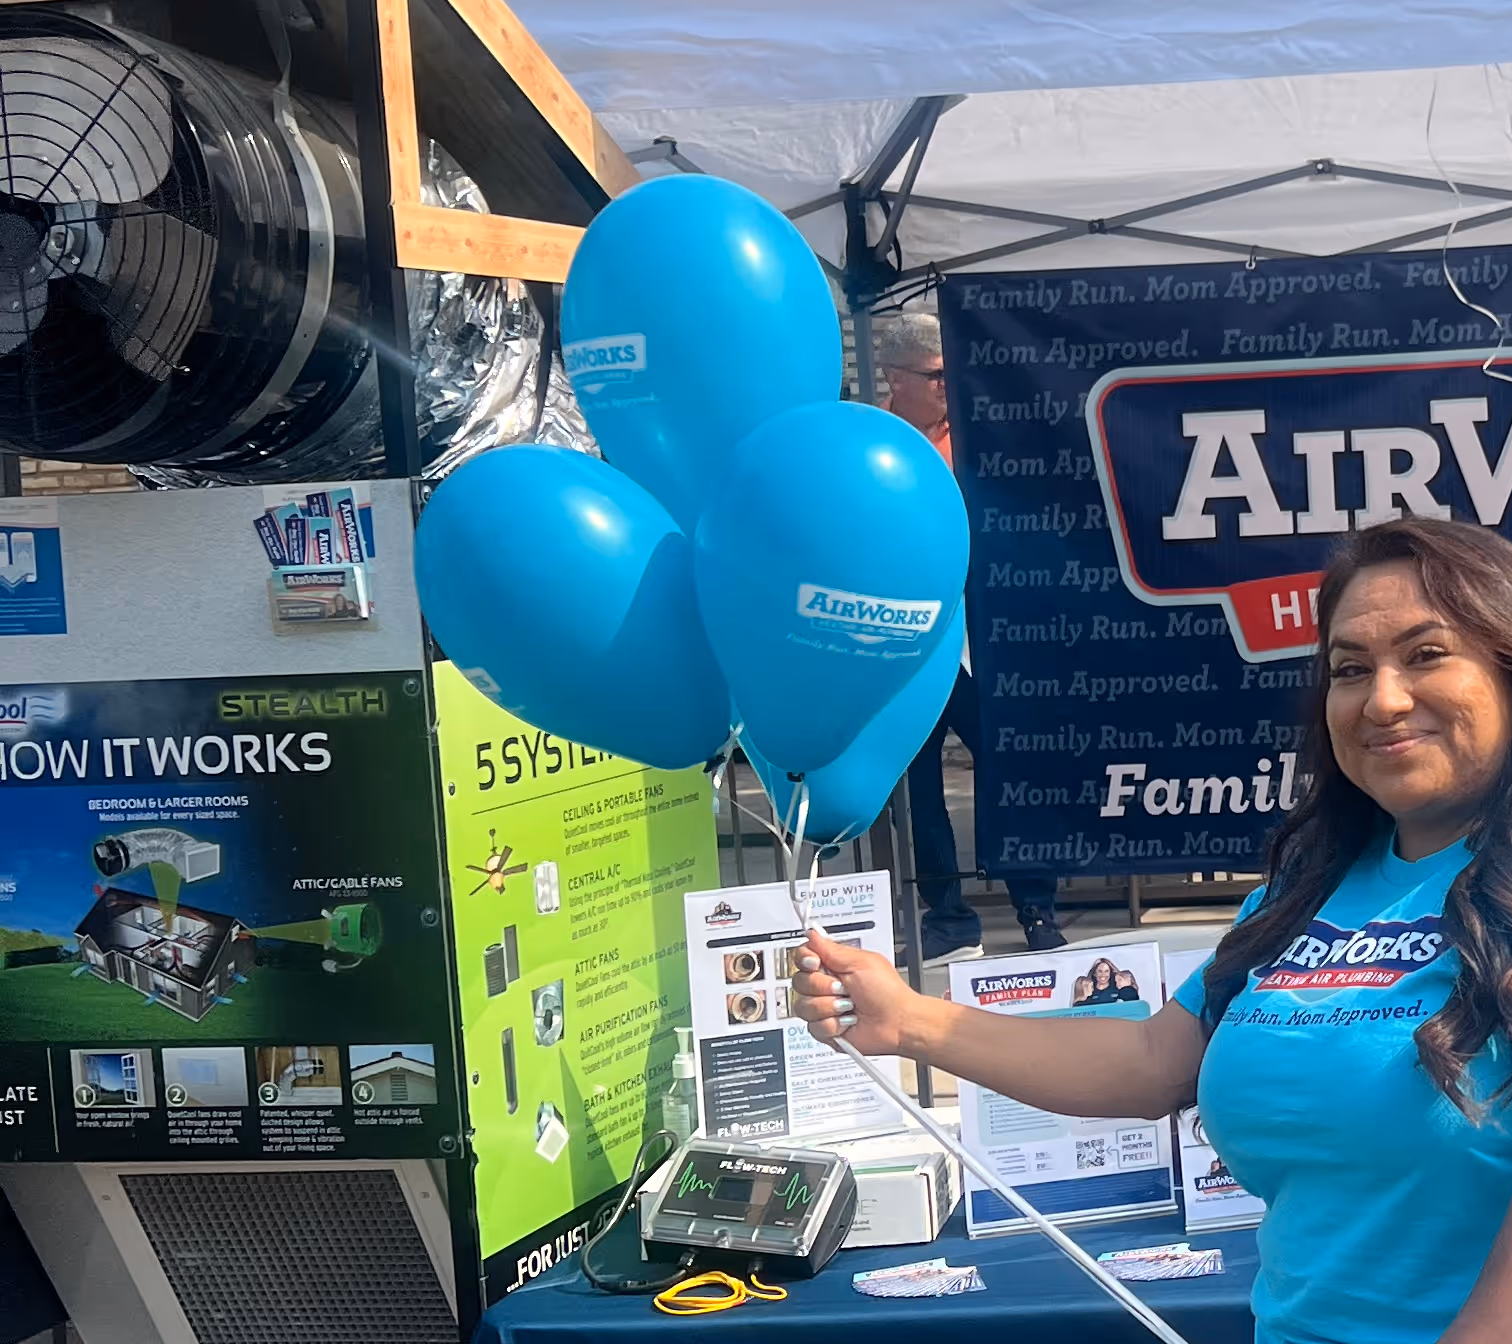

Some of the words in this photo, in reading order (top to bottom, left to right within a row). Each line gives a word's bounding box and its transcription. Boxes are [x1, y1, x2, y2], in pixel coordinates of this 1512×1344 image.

[961, 280, 1061, 313] Family
[1069, 279, 1136, 306] Run.
[1144, 275, 1219, 303] Mom
[1224, 262, 1382, 304] Approved.
[1402, 255, 1509, 290] Family
[970, 390, 1070, 426] Family
[806, 591, 932, 625] AIRWORKS
[222, 690, 385, 718] STEALTH
[102, 737, 140, 778] IT
[147, 732, 332, 777] WORKS
[476, 742, 495, 791] 5
[1100, 752, 1314, 818] Famil
[88, 798, 147, 810] BEDROOM
[149, 798, 156, 808] &
[158, 797, 204, 808] LARGER
[205, 795, 249, 806] ROOMS
[563, 803, 595, 823] CEILING
[597, 801, 602, 814] &
[604, 789, 643, 811] PORTABLE
[644, 783, 664, 801] FANS
[370, 876, 403, 889] FANS
[568, 869, 606, 891] CENTRAL
[607, 863, 621, 878] A/C
[821, 888, 838, 898] UP
[842, 884, 874, 895] WITH
[575, 955, 598, 976] ATTIC
[599, 948, 620, 964] FANS
[1271, 930, 1444, 970] IRWORKS
[976, 974, 1053, 994] AIRWORKS
[1310, 972, 1331, 985] AIR
[1335, 970, 1396, 985] PLUMBING
[985, 990, 1018, 1003] FAMILY
[1020, 989, 1044, 999] PLAN
[580, 1027, 594, 1044] AIR
[595, 1003, 648, 1037] PURIFICATION
[649, 994, 669, 1013] FANS
[1247, 1007, 1282, 1026] Run.
[1283, 1009, 1325, 1027] Mom
[1326, 999, 1429, 1027] Approved.
[584, 1092, 606, 1112] BATH
[614, 1073, 646, 1096] KITCHEN
[1198, 1175, 1238, 1189] AIRWO
